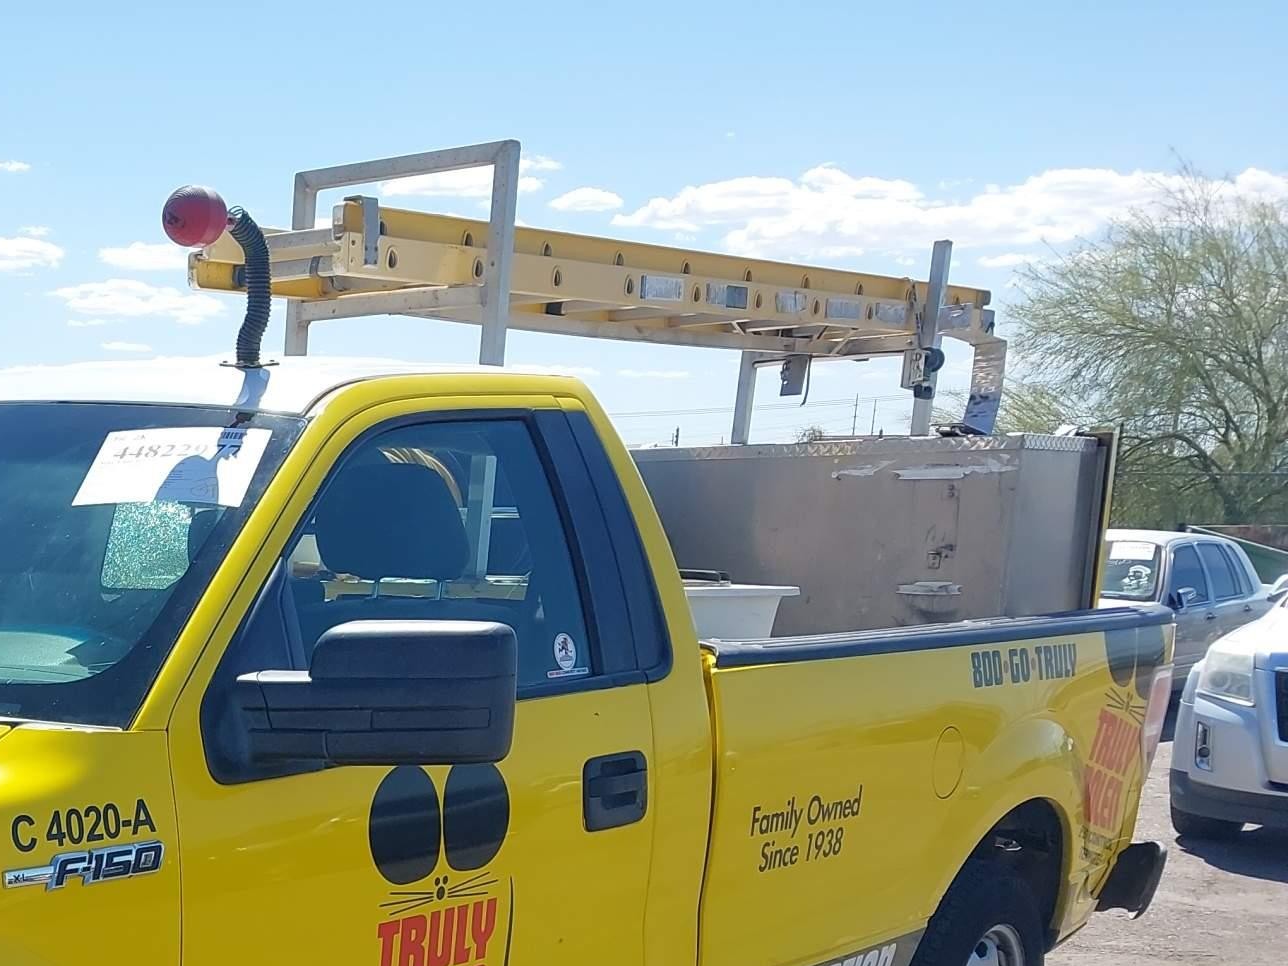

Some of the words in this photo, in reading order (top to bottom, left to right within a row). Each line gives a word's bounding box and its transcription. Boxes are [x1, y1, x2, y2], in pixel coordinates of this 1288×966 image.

[11, 814, 38, 853] C
[46, 798, 157, 847] 4020-A
[750, 796, 804, 838] Family
[807, 784, 863, 825] Owned
[758, 840, 800, 873] Since
[805, 827, 844, 862] 1938
